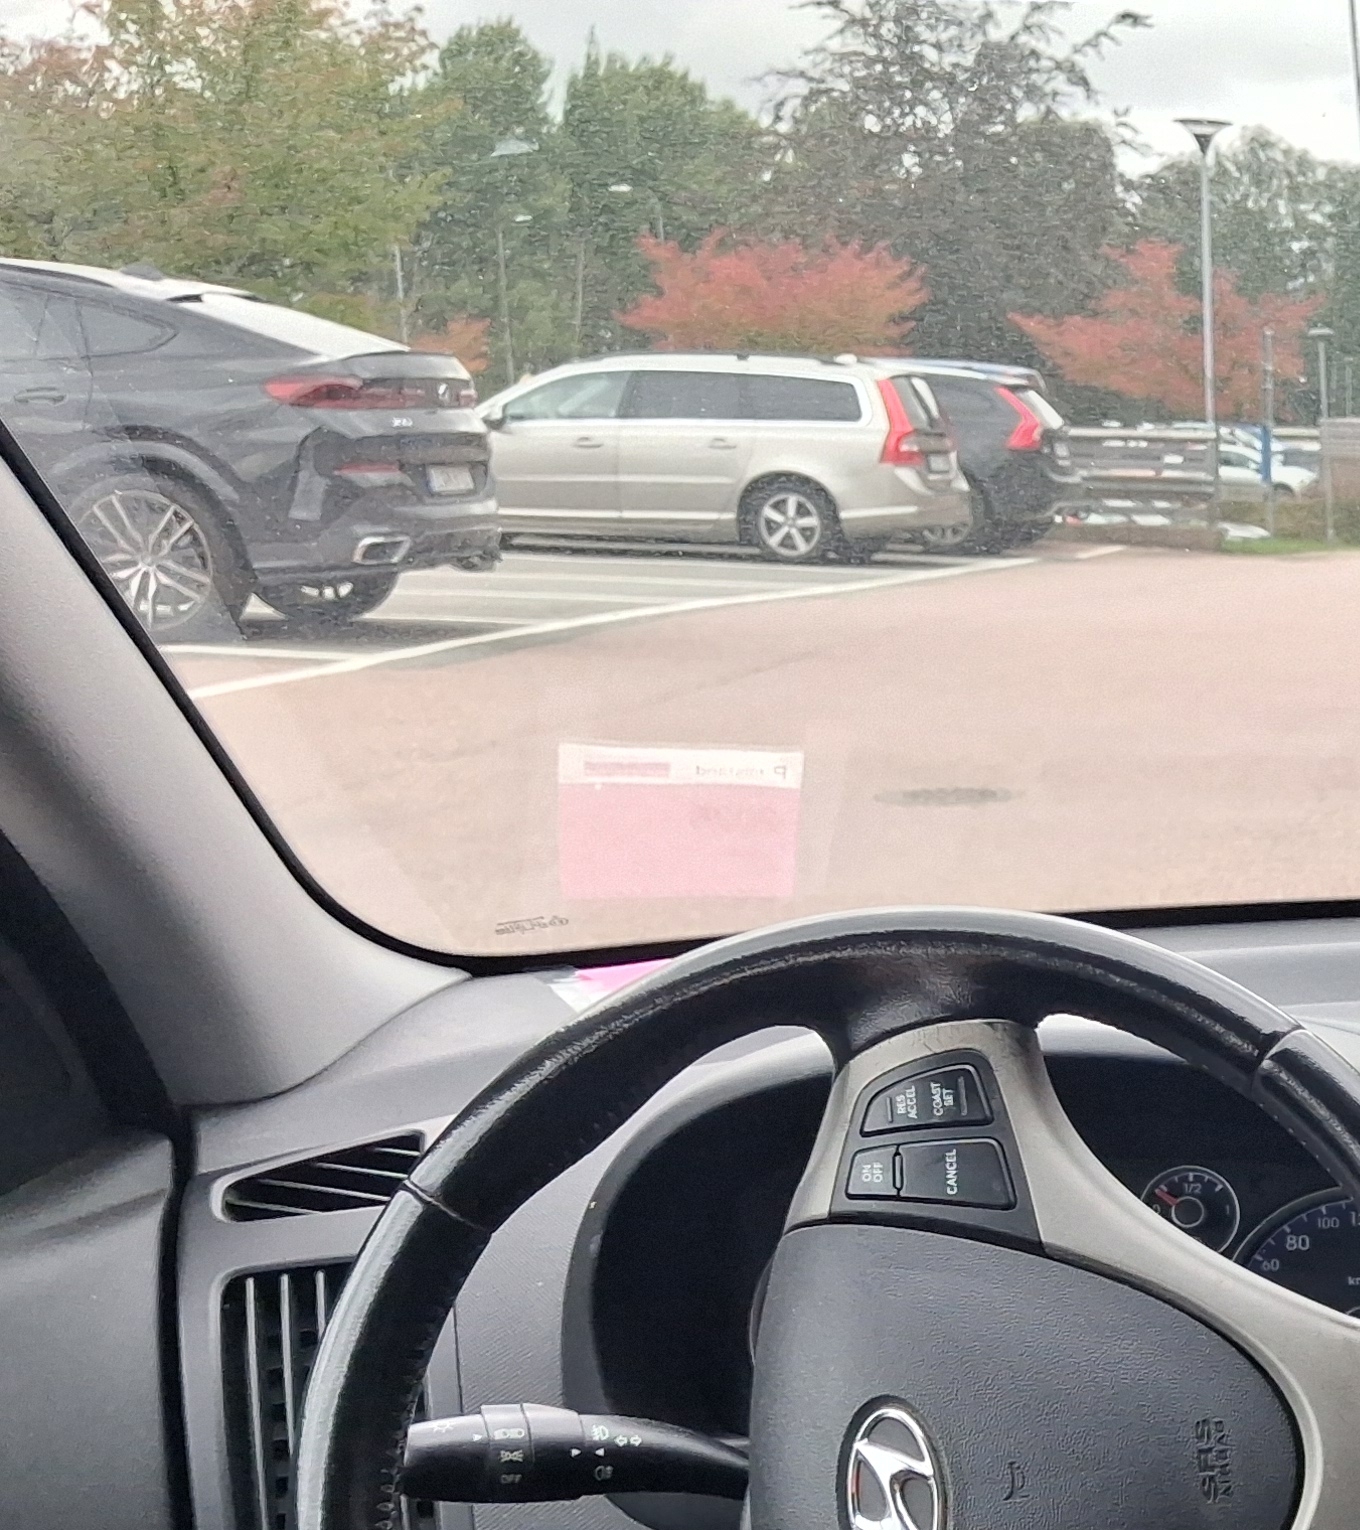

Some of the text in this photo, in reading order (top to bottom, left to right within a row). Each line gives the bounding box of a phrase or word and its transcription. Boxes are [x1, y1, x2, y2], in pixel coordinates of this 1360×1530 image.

[905, 1085, 918, 1120] ACCEL
[930, 1081, 943, 1117] COAST
[861, 1164, 872, 1183] ON
[873, 1161, 884, 1183] OFF
[944, 1148, 958, 1195] CANCEL
[1316, 1216, 1341, 1229] 100
[1286, 1234, 1311, 1252] 80
[1261, 1258, 1281, 1272] 60
